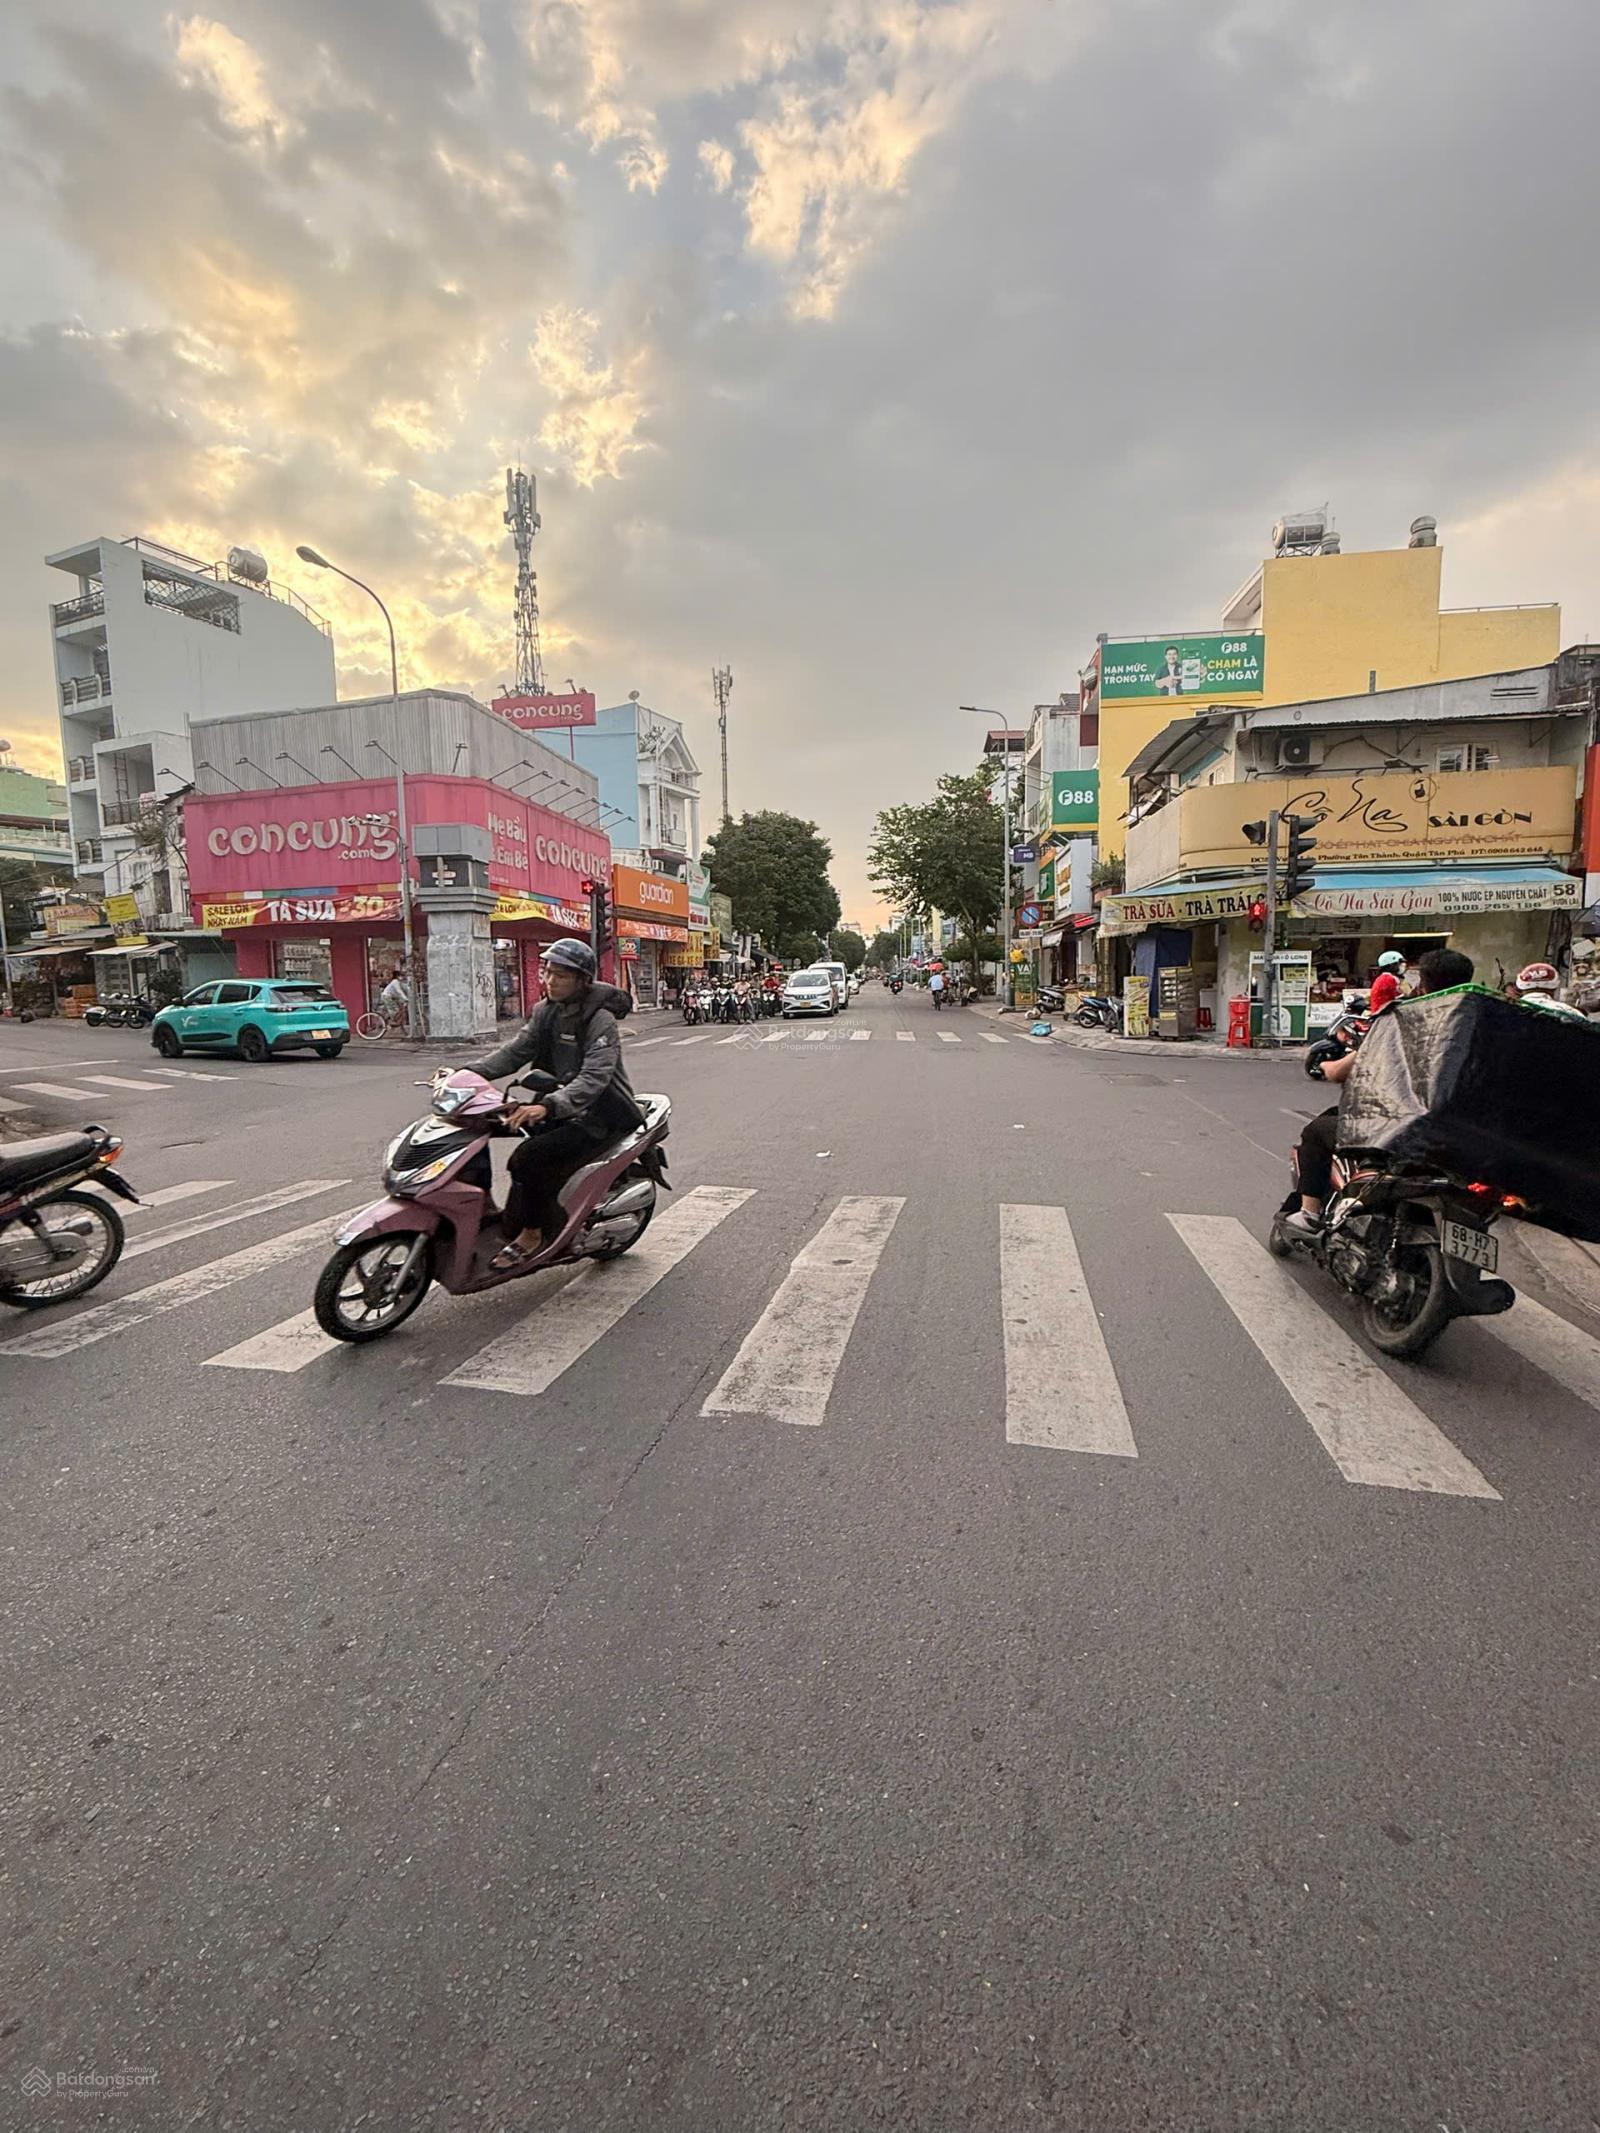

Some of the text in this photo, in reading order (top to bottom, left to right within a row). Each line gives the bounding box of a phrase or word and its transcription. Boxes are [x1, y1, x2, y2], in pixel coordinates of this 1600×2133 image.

[1221, 641, 1248, 653] F88
[1104, 663, 1147, 675] HẠN MỨC
[1207, 656, 1258, 670] CHẠM LÀ
[1104, 673, 1156, 684] TRONG TAY
[1207, 669, 1260, 681] CÓ NGAY
[502, 703, 584, 721] concung
[1058, 789, 1094, 806] F88
[1428, 811, 1469, 828] SÀI
[1474, 808, 1533, 826] GÒN
[207, 813, 397, 861] concung
[640, 880, 674, 905] guardian
[1438, 892, 1460, 902] 100%
[1553, 884, 1576, 896] 58
[1123, 901, 1146, 920] TRÀ
[1149, 899, 1175, 919] SỮA
[1185, 895, 1214, 916] TRÀ
